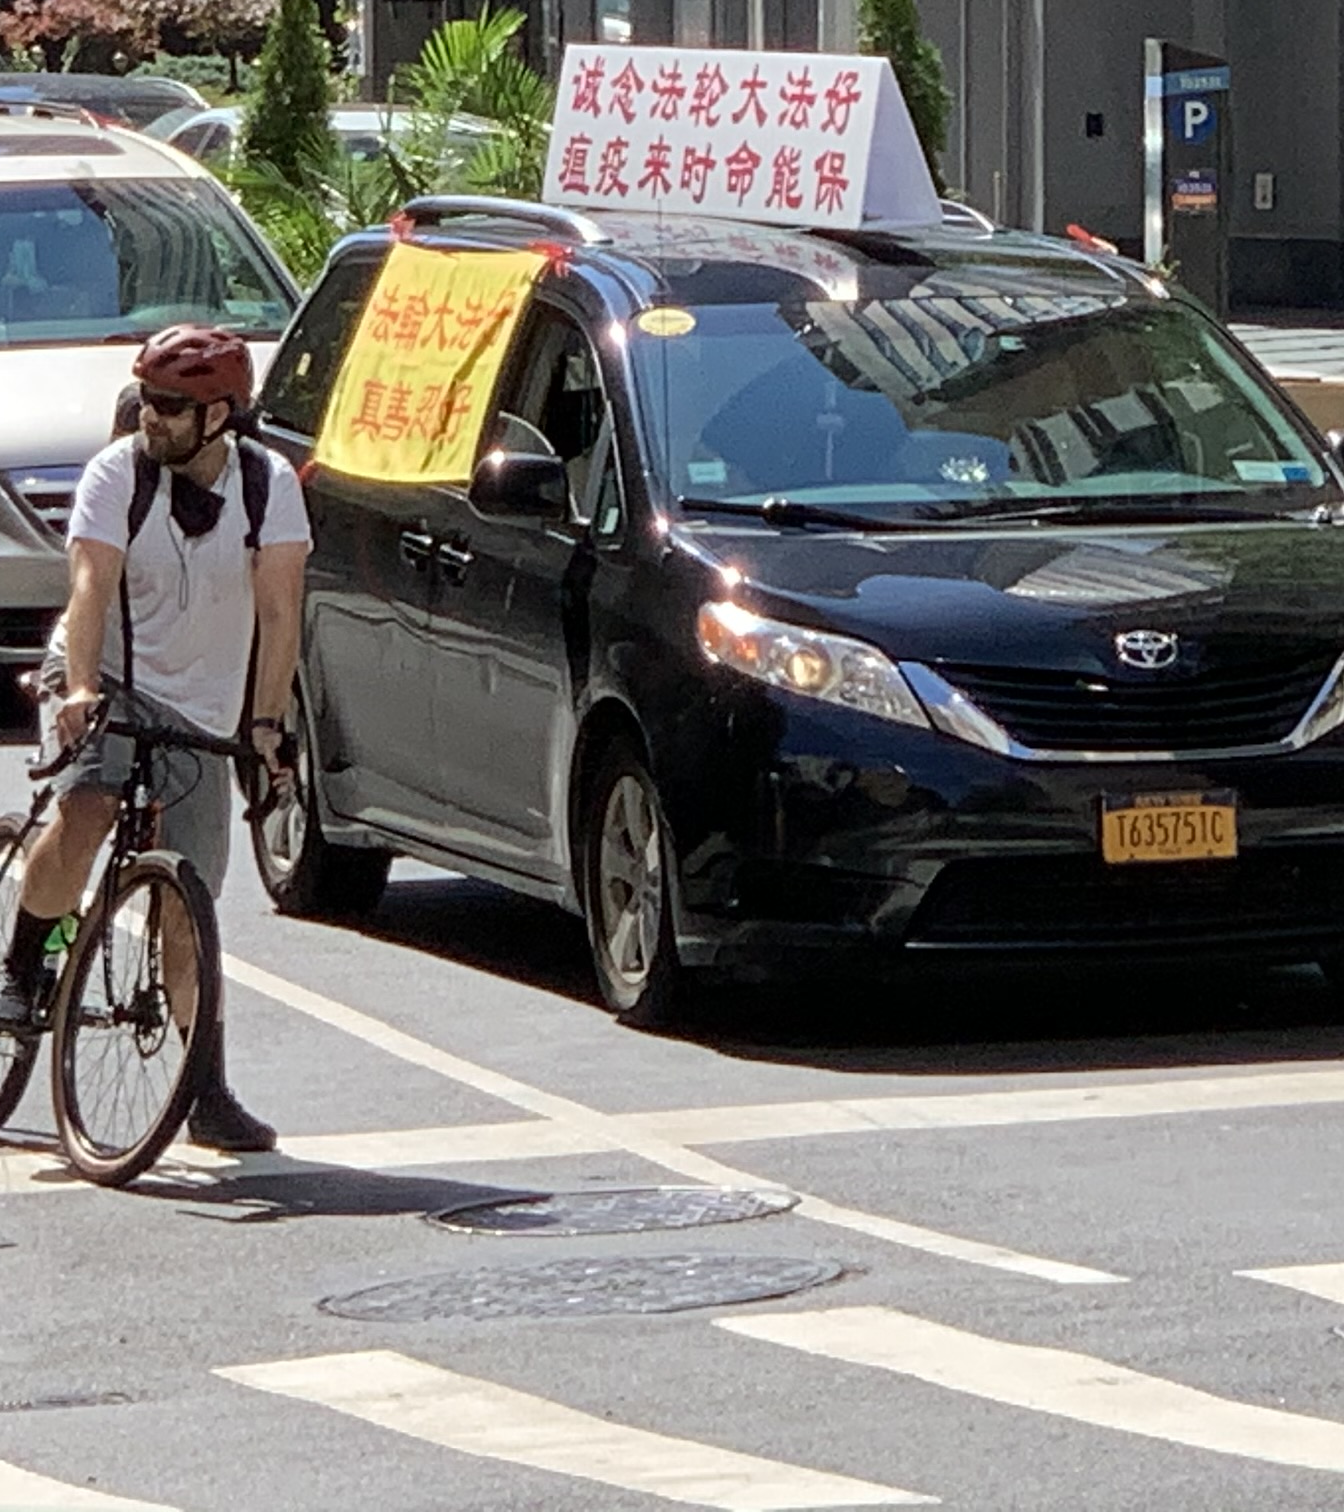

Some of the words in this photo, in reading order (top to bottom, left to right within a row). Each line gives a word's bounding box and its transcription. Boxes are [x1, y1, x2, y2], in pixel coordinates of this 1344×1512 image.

[571, 55, 862, 136] 诚念法轮大法好
[1184, 100, 1208, 139] P
[558, 132, 850, 215] 瘟疫来时命能保
[1116, 811, 1223, 847] T635751C
